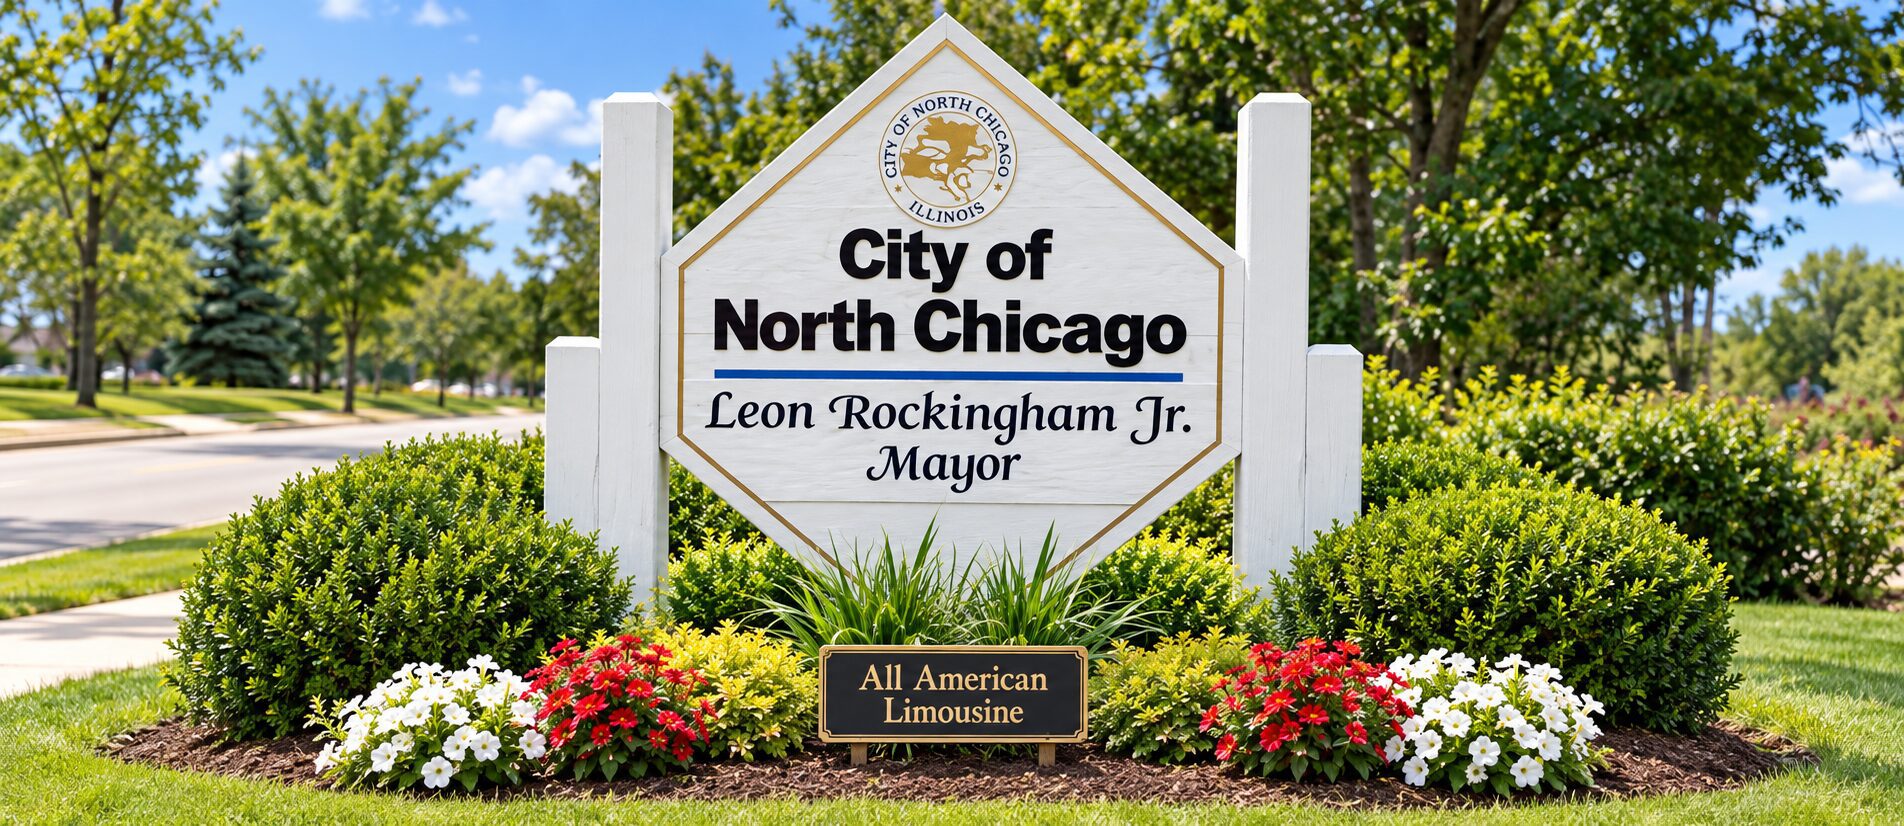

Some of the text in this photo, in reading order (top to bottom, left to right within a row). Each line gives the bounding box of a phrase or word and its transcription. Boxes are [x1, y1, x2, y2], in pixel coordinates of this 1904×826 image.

[884, 96, 1012, 179] CITY OF NORTH CHICAGO
[909, 200, 985, 223] ILLINOIS
[839, 228, 1054, 293] City of
[713, 298, 1188, 368] North Chicago
[705, 390, 1193, 446] Leon Rockingham Jr.
[866, 445, 1022, 493] Mayor
[858, 663, 1048, 691] All American
[883, 697, 1024, 724] Limousine
